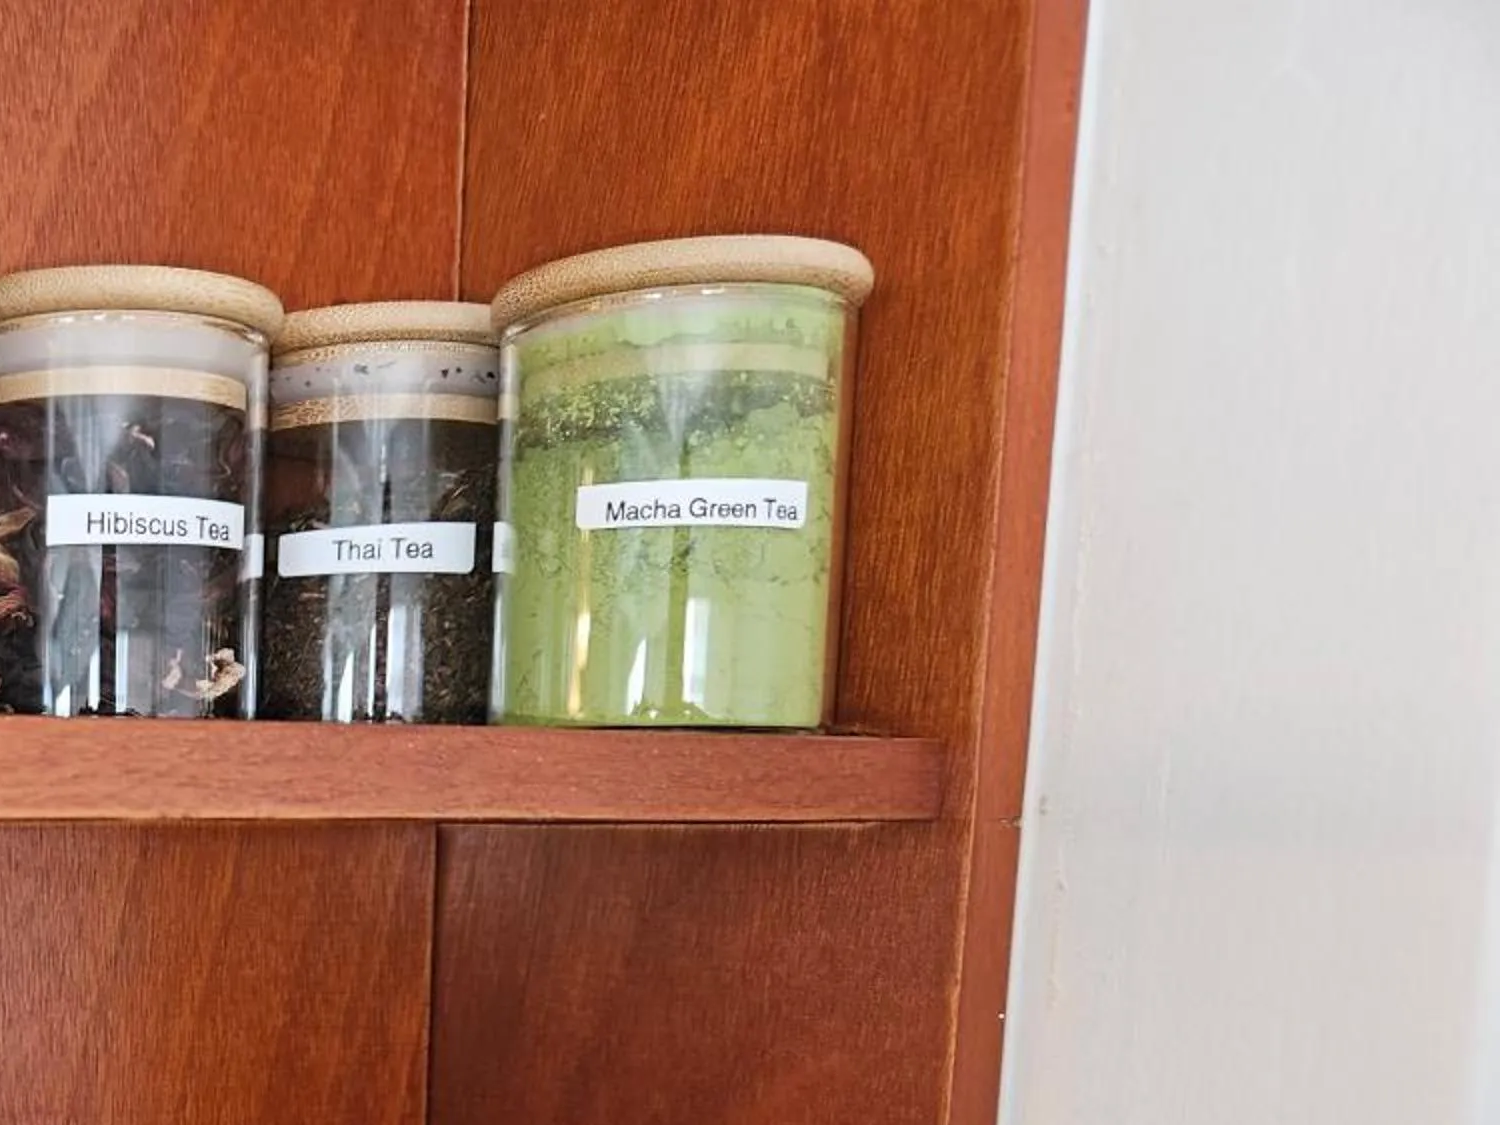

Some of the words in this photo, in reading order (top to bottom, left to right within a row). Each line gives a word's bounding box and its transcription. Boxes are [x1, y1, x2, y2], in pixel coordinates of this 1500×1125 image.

[605, 499, 681, 523] Macha
[688, 497, 757, 519] Green
[763, 498, 798, 521] Tea
[86, 511, 189, 537] Hibiscus
[196, 515, 230, 541] Tea
[331, 538, 382, 561] Thai
[390, 537, 434, 560] Tea
